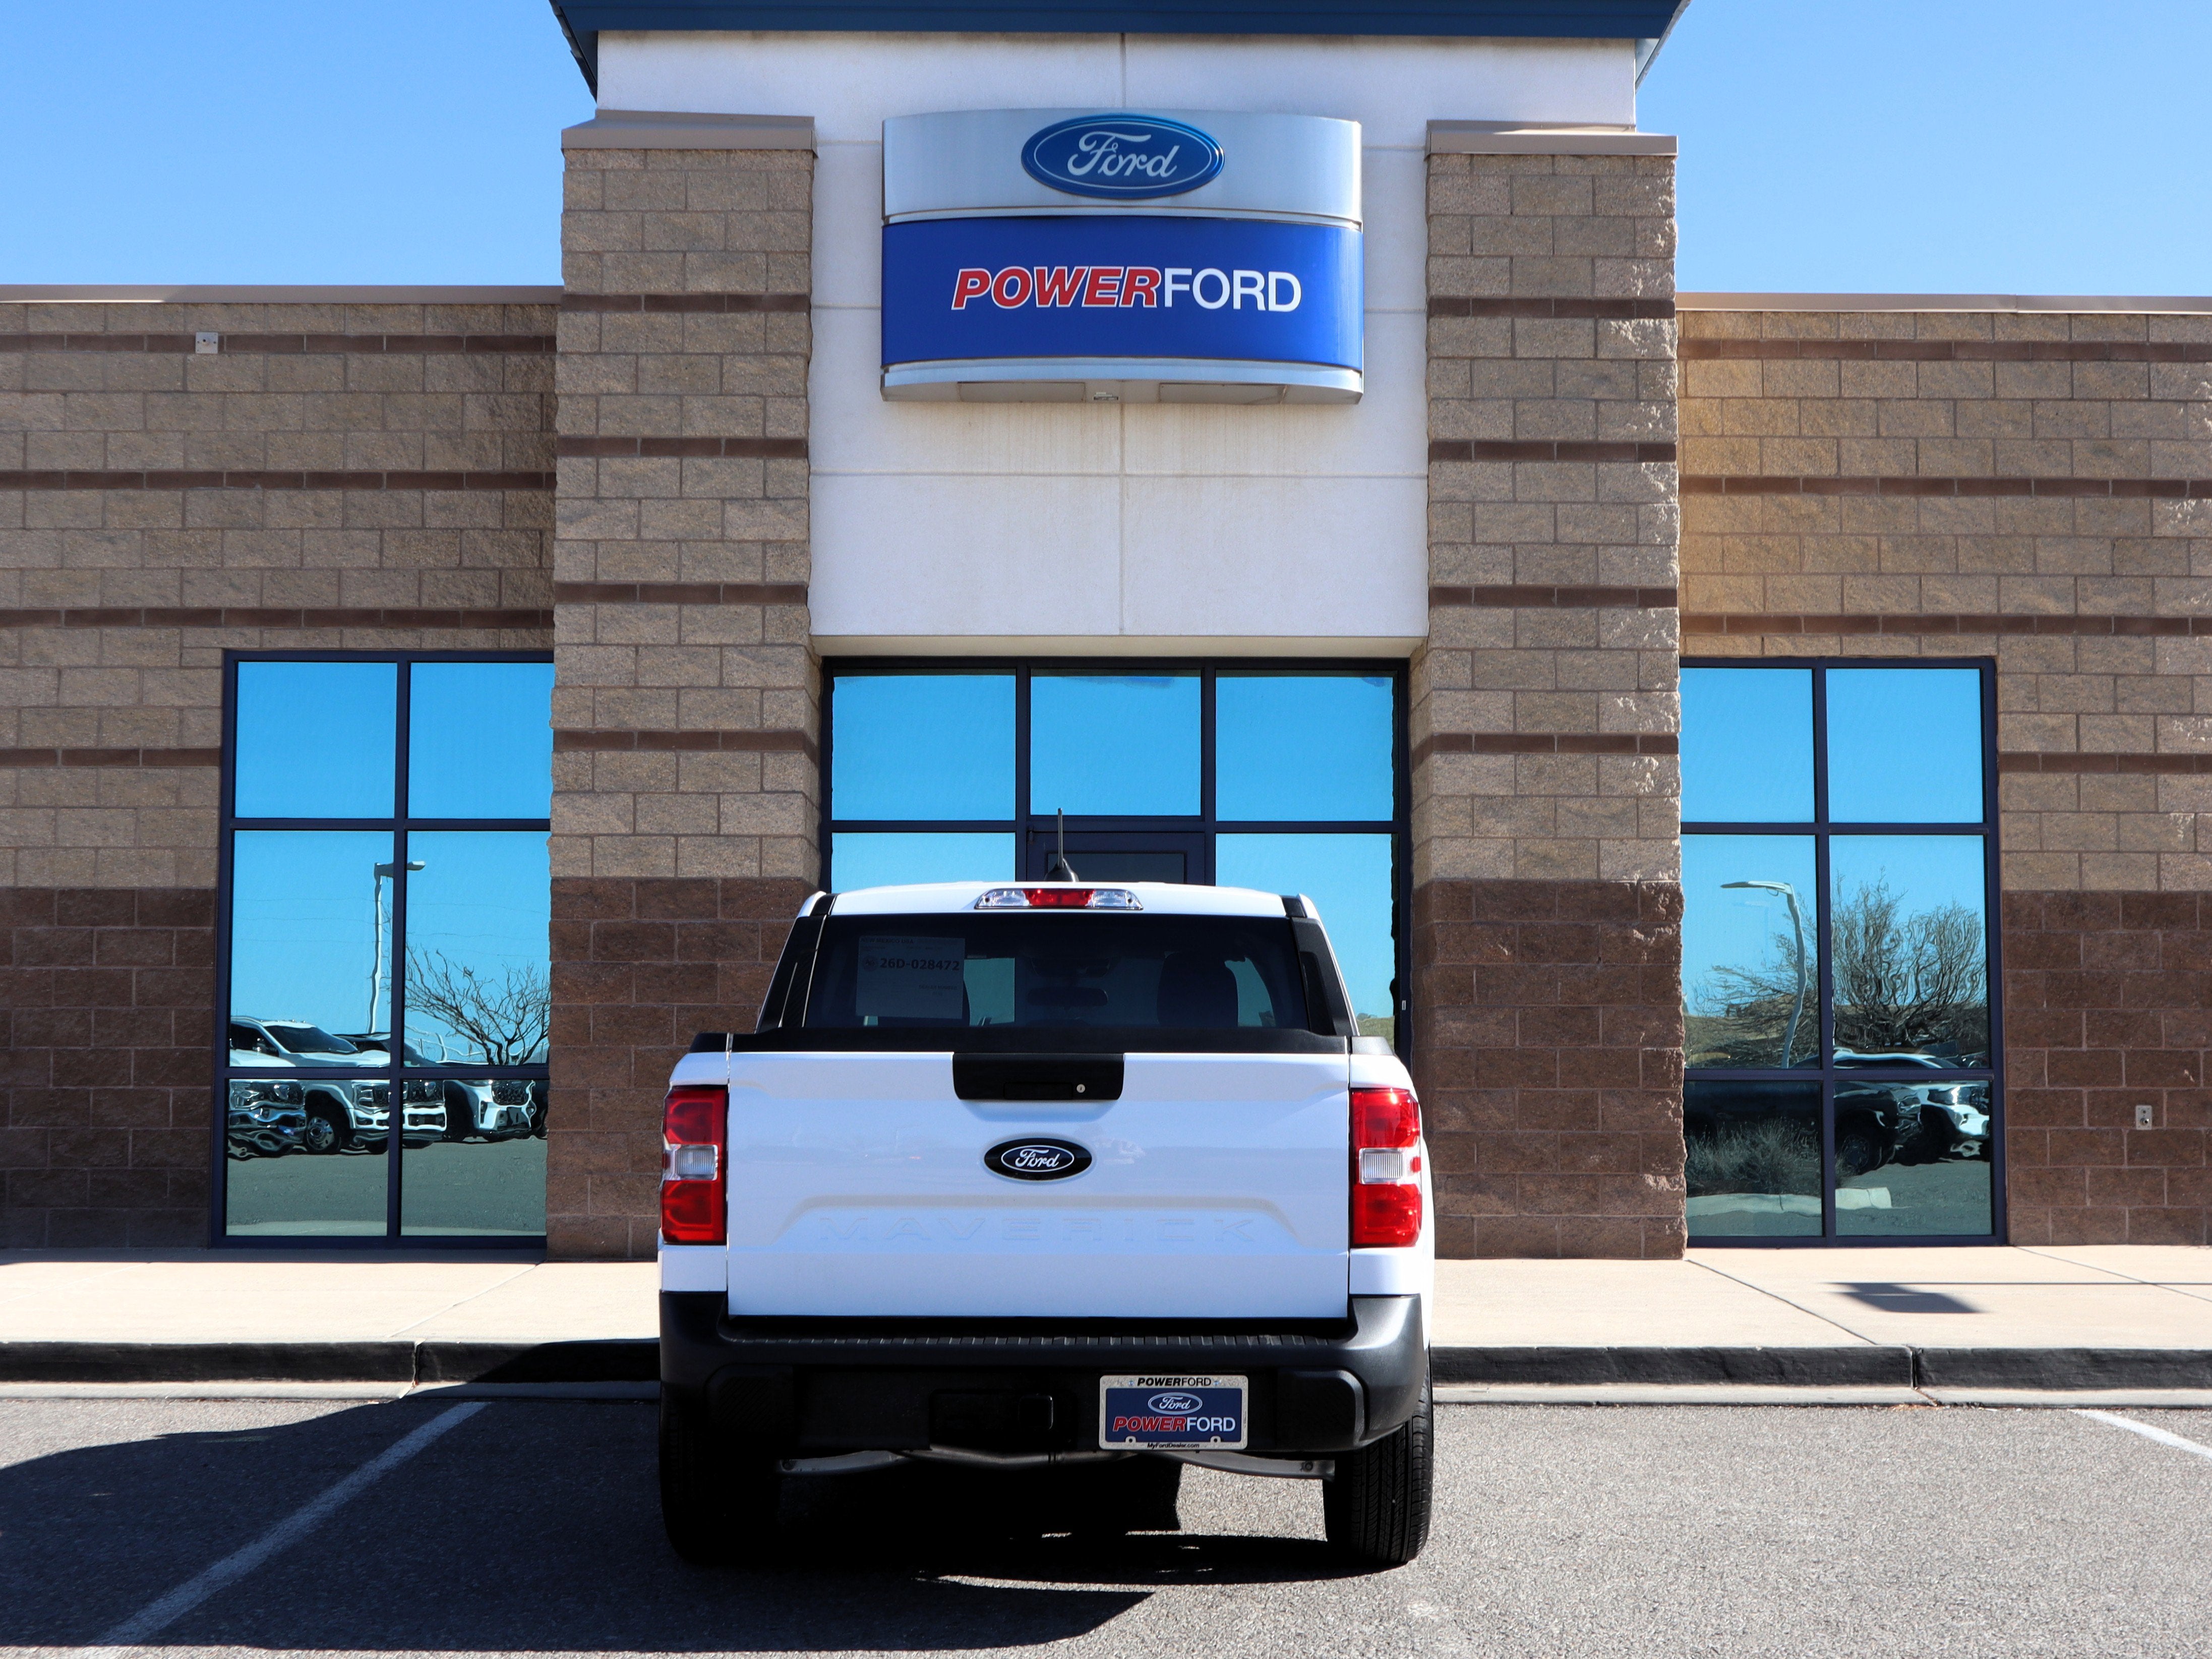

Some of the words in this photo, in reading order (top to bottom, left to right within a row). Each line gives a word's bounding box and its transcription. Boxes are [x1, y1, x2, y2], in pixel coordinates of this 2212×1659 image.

[1067, 131, 1180, 177] Ford
[950, 265, 1302, 312] POWERFORD
[880, 958, 960, 971] 26D-028472
[1015, 1149, 1060, 1167] Ford
[819, 1217, 1256, 1242] MAVERICK
[1137, 1377, 1211, 1387] POWERFORD
[1159, 1396, 1191, 1410] Ford
[1113, 1416, 1236, 1432] POWERFORD
